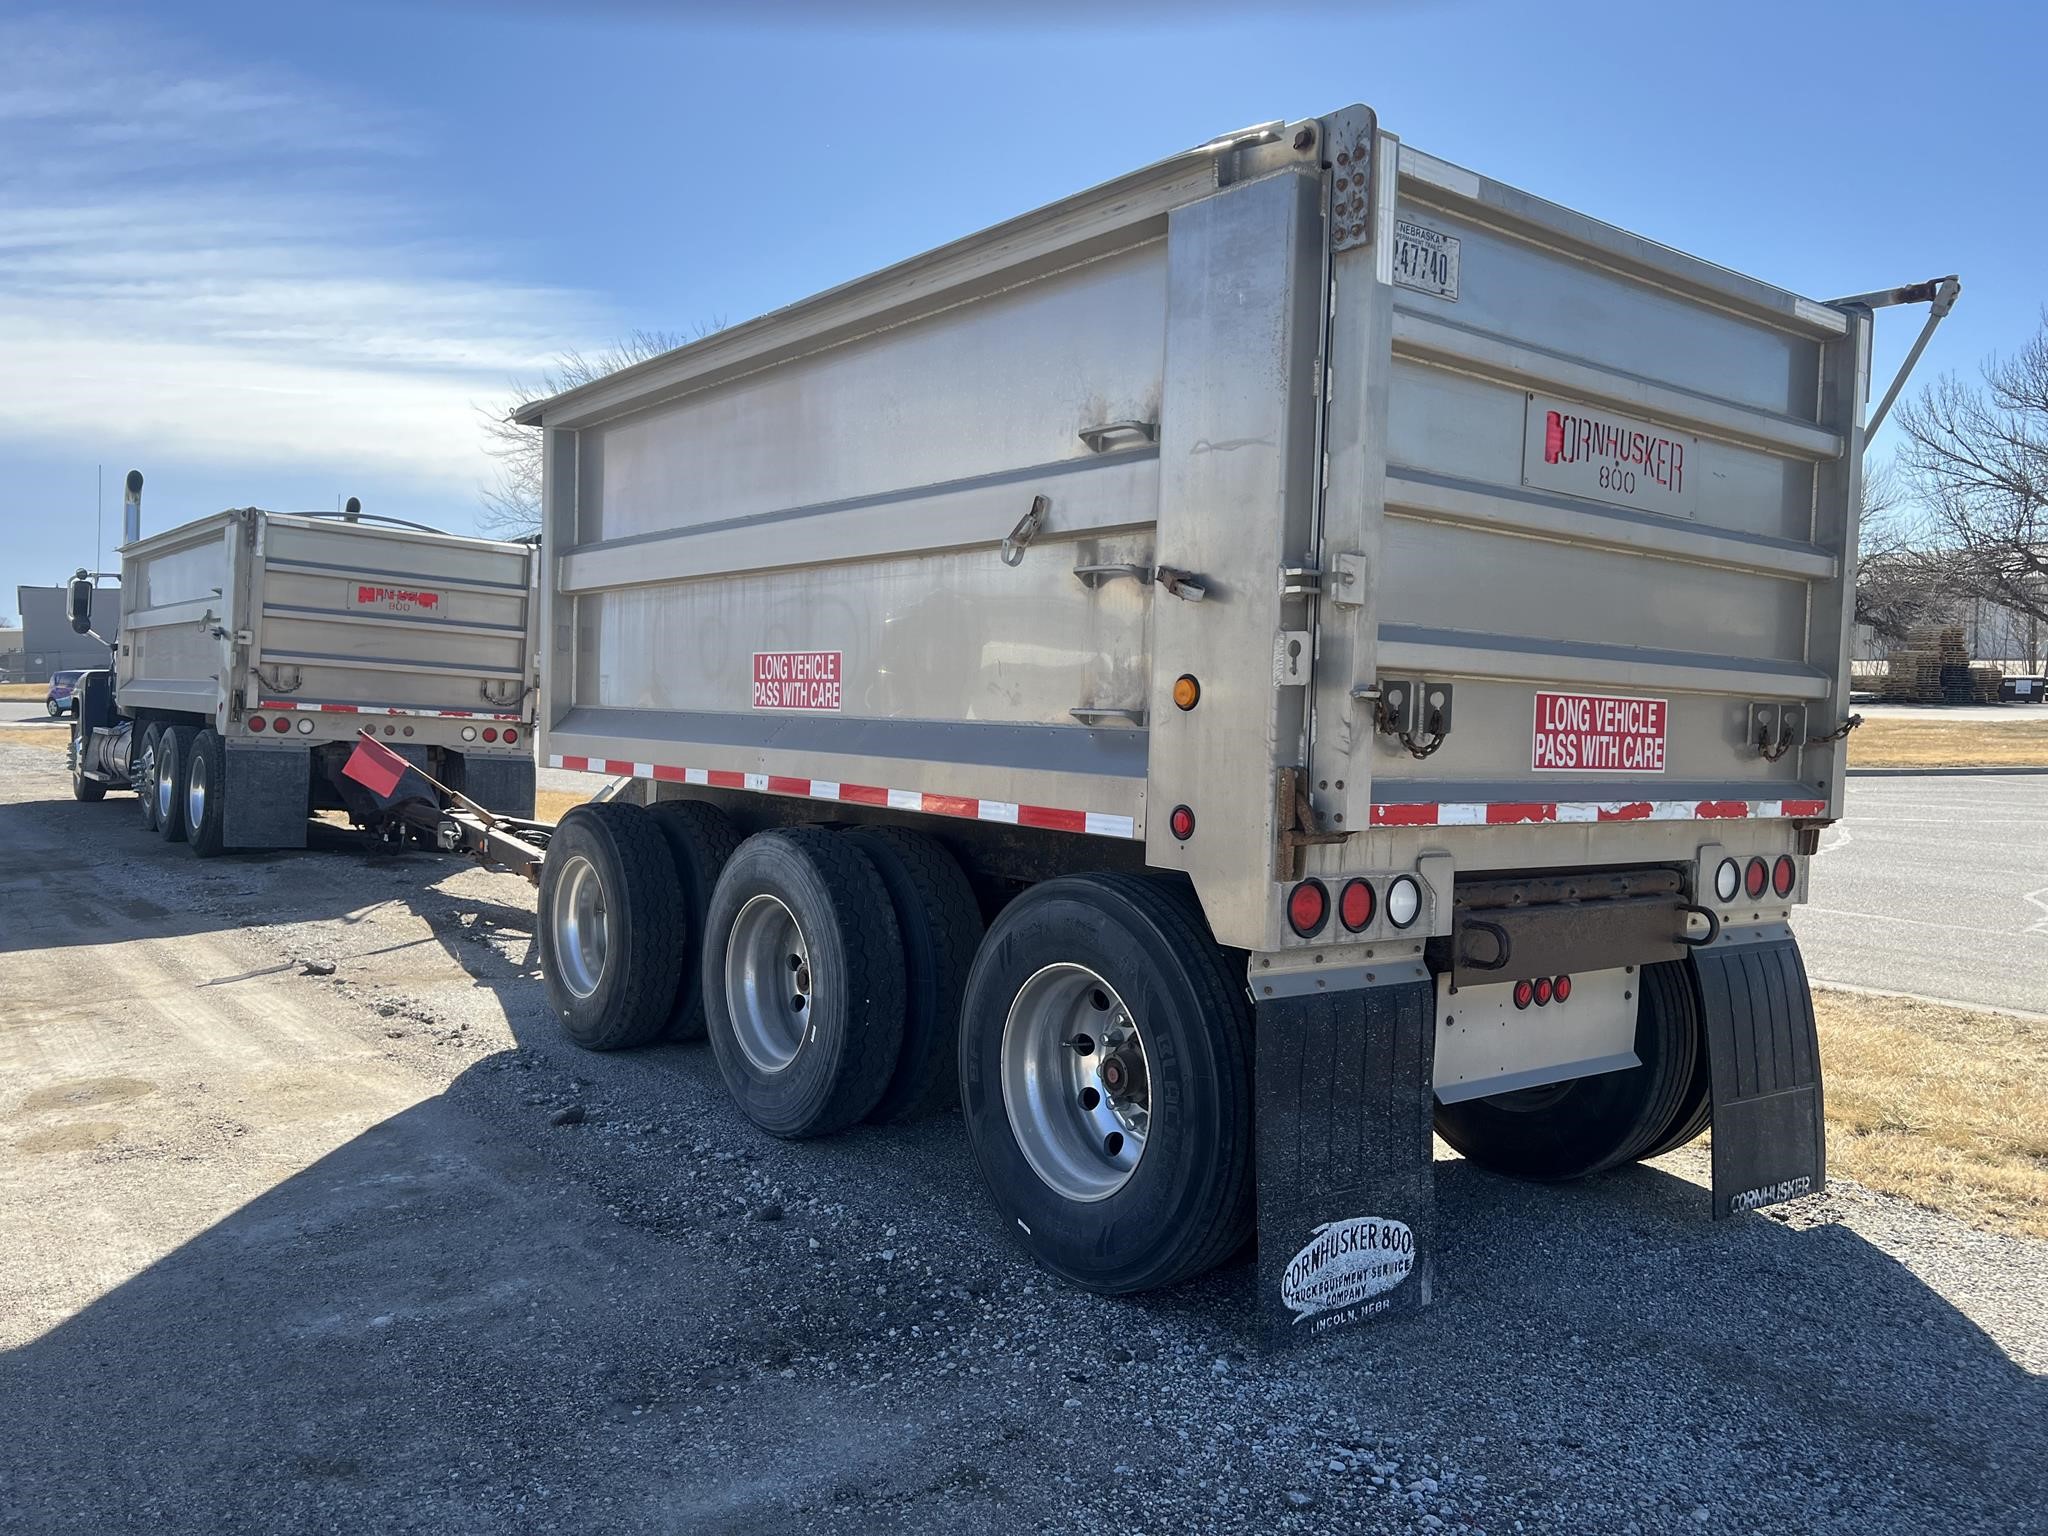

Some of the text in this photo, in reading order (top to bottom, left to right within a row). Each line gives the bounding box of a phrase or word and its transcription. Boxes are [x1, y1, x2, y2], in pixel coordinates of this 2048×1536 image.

[1400, 224, 1440, 244] NEBRASKA
[1599, 465, 1635, 494] 800
[759, 654, 835, 680] LONG VEHICLE
[754, 681, 840, 707] PASS WITH CARE
[1545, 697, 1658, 734] LONG VEHICLE
[1535, 733, 1664, 768] PASS WITH CARE
[1730, 1175, 1812, 1214] CORNHUSKER
[1283, 1223, 1412, 1298] CORNHUSKER 800
[1290, 1284, 1318, 1306] TRUCK
[1318, 1269, 1368, 1295] EQUIPMENT
[1325, 1284, 1367, 1307] COMPANY
